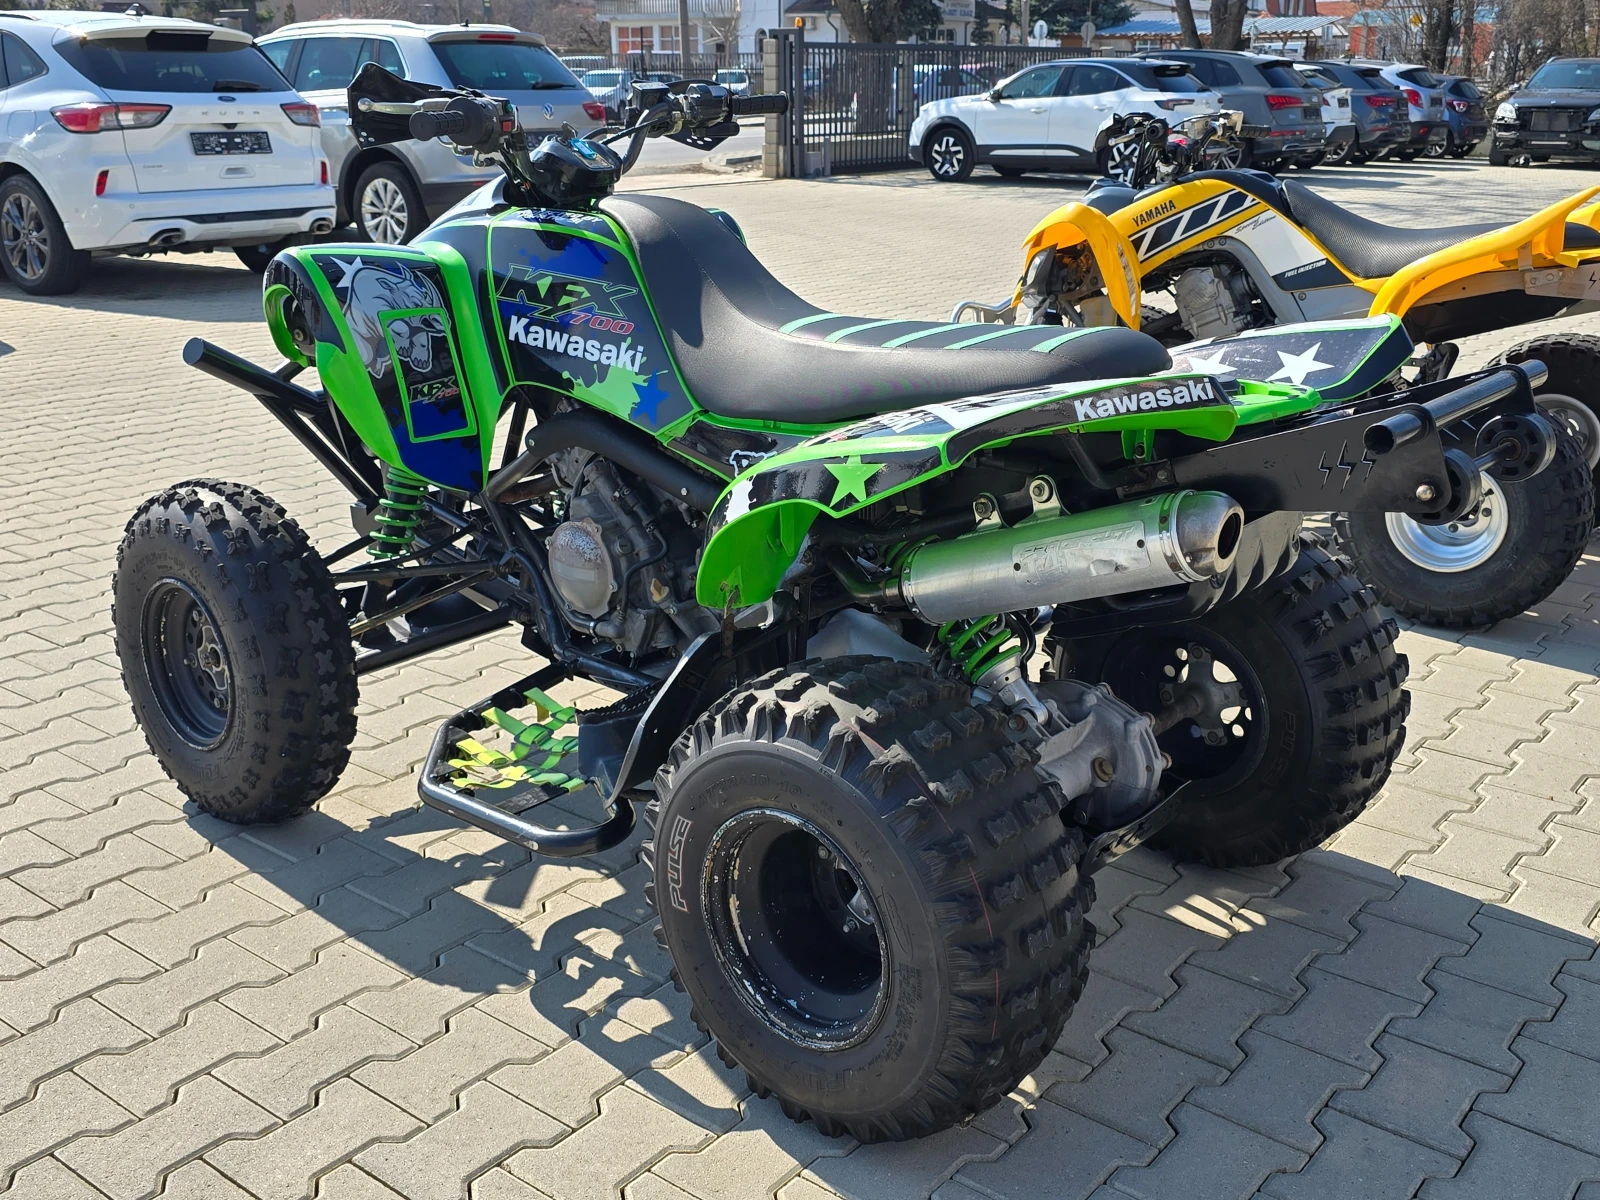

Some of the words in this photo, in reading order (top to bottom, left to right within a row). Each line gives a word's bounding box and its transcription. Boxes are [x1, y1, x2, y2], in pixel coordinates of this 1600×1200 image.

[1132, 199, 1177, 227] YAMAHA
[1284, 268, 1298, 278] FUEL
[1297, 259, 1327, 274] INJECTION
[494, 263, 639, 322] KFX
[568, 311, 635, 335] 700
[508, 315, 644, 373] Kawasaki
[408, 375, 456, 404] KFX
[438, 388, 459, 399] 700
[1073, 377, 1215, 422] Kawasaki
[667, 815, 694, 914] PULSE
